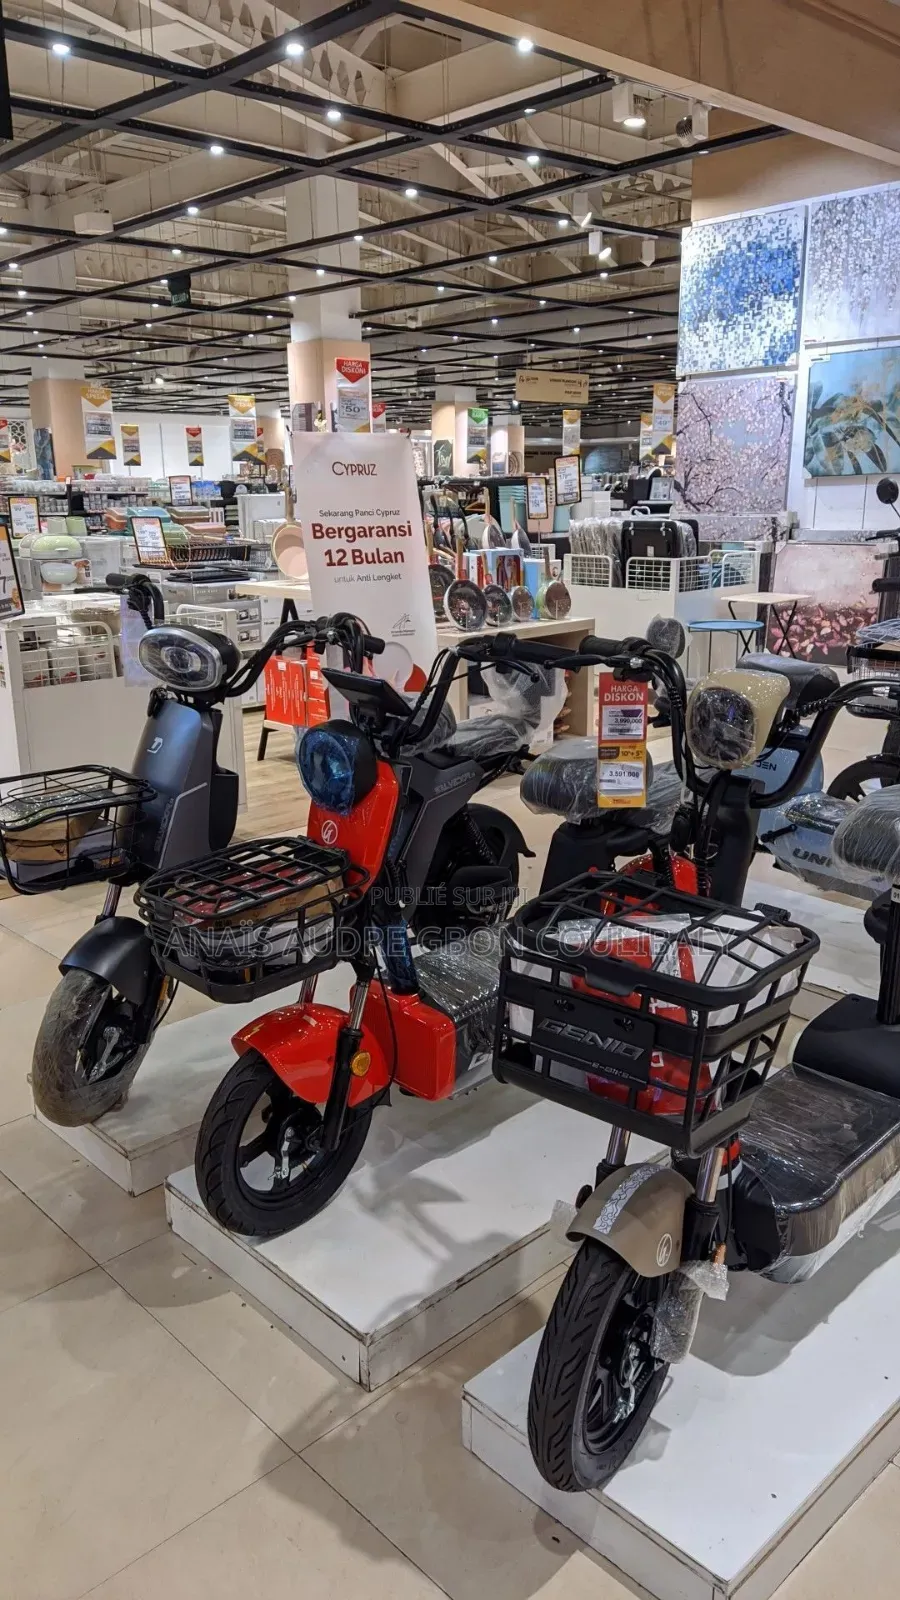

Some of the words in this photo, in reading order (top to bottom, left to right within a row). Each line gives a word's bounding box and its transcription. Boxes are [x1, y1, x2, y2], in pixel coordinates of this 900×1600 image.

[319, 509, 354, 518] Sekarang
[354, 509, 375, 517] Panci
[375, 509, 401, 517] Cypruz
[311, 520, 413, 543] Bergaransi
[324, 548, 349, 567] 12
[351, 547, 405, 565] Bulan
[333, 575, 355, 583] untuk
[356, 574, 371, 582] Anti
[372, 573, 402, 583] Lengket
[604, 692, 644, 702] DISKON
[536, 1017, 645, 1061] GENIO
